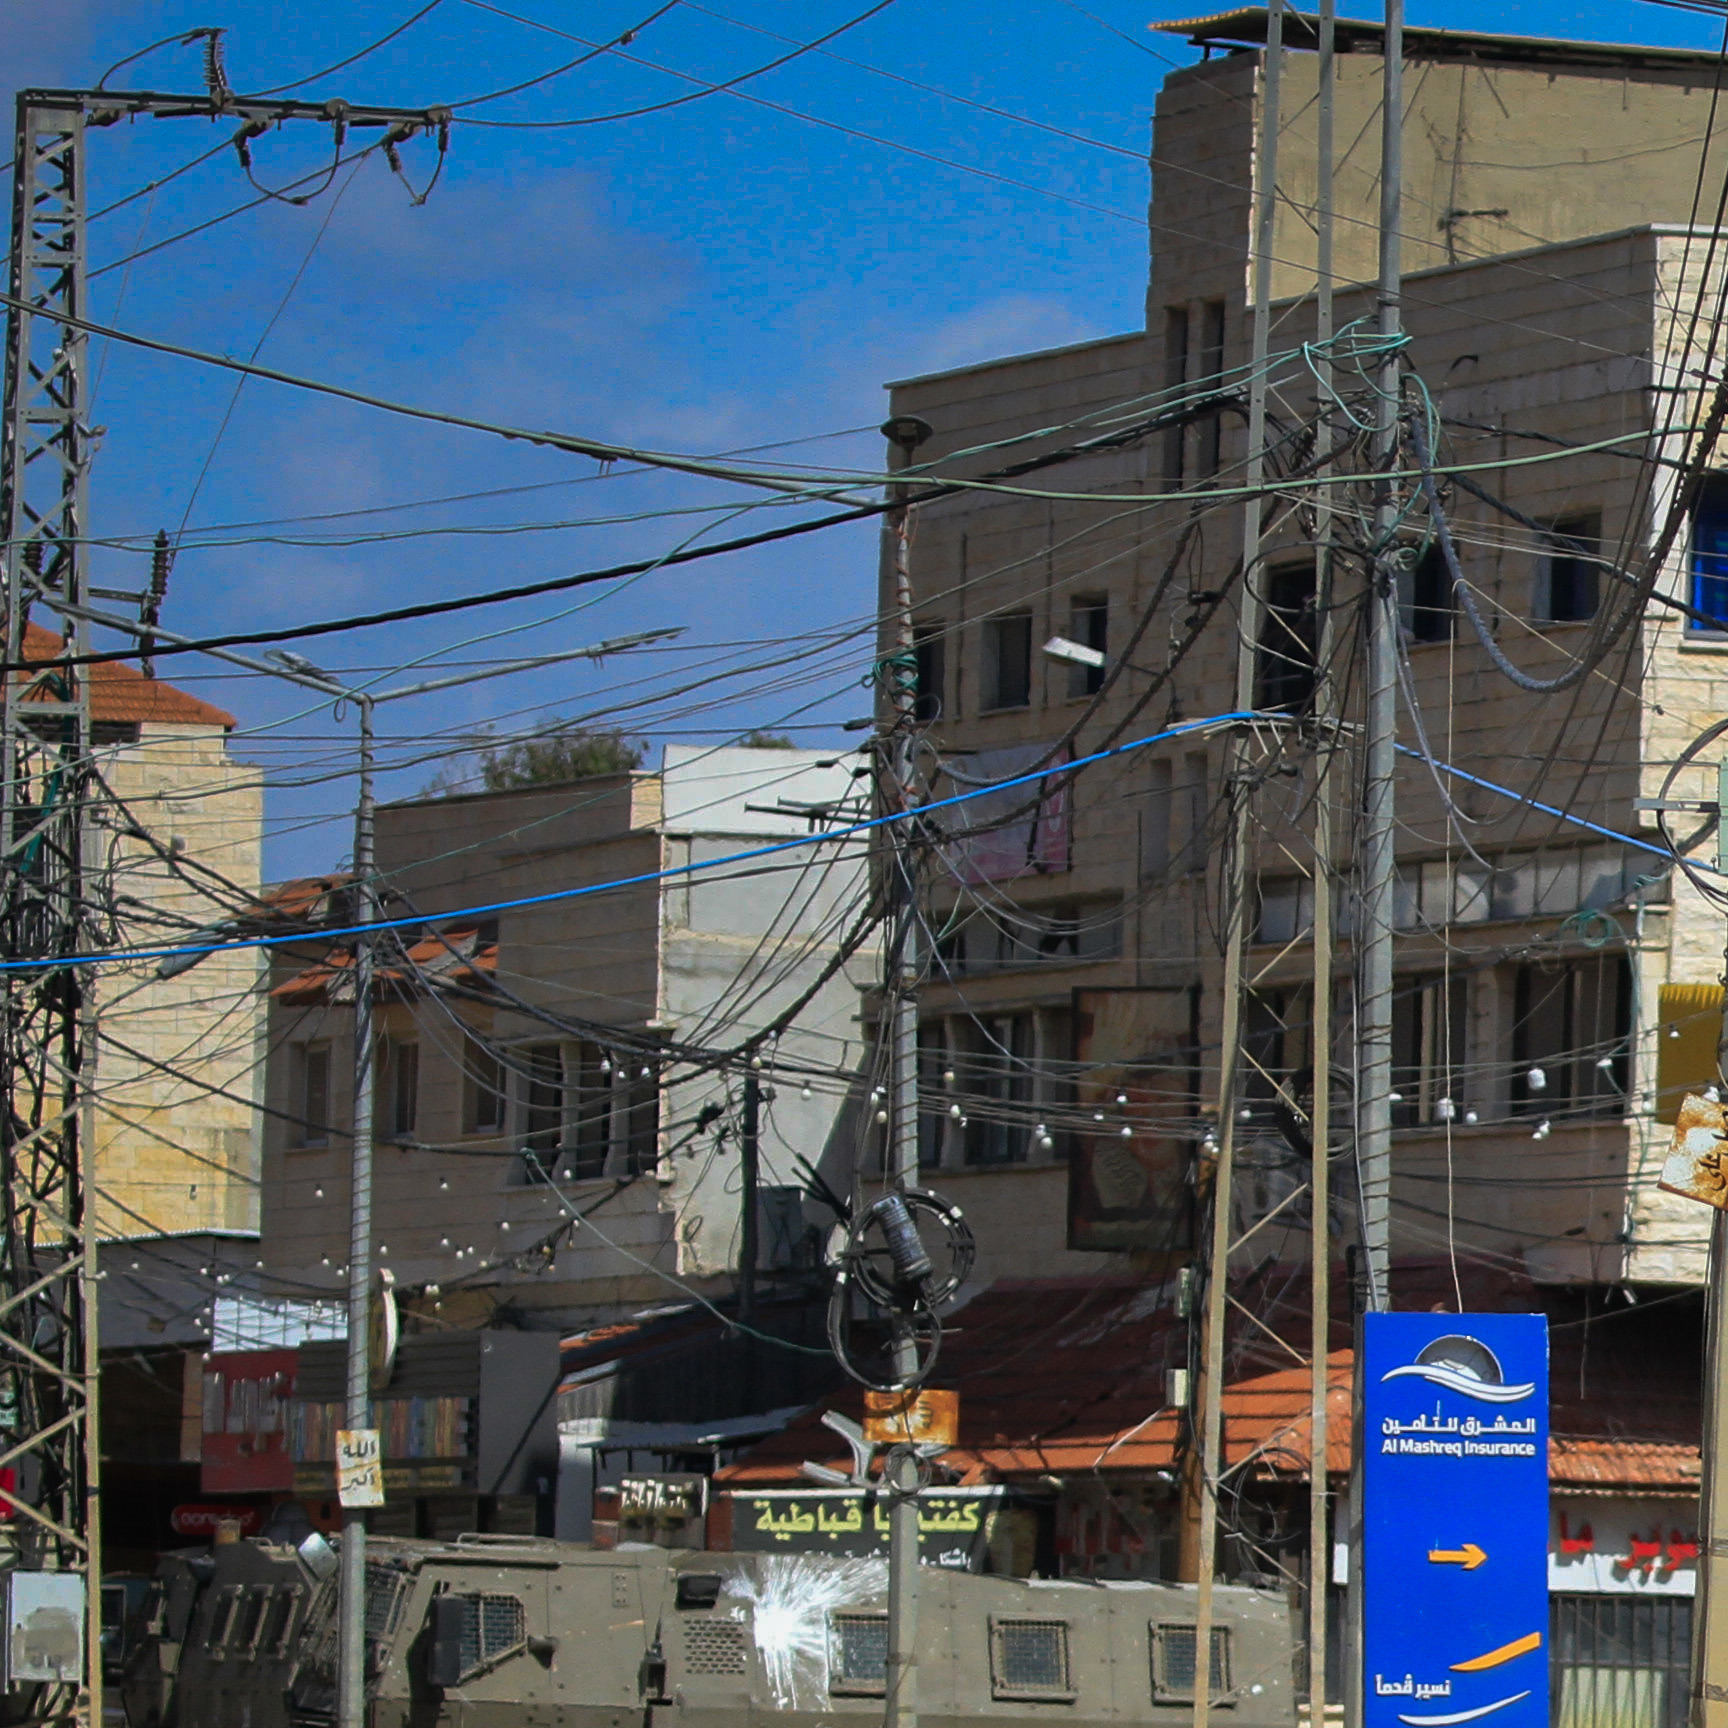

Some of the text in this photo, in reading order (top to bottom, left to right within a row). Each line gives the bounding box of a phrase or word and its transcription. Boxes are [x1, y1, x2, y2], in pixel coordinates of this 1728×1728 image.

[1382, 1413, 1536, 1437] المشرق للتأمين
[1382, 1438, 1536, 1457] Al Mashreq Insurance
[181, 1510, 254, 1527] ooredo
[1415, 1679, 1451, 1699] نسير
